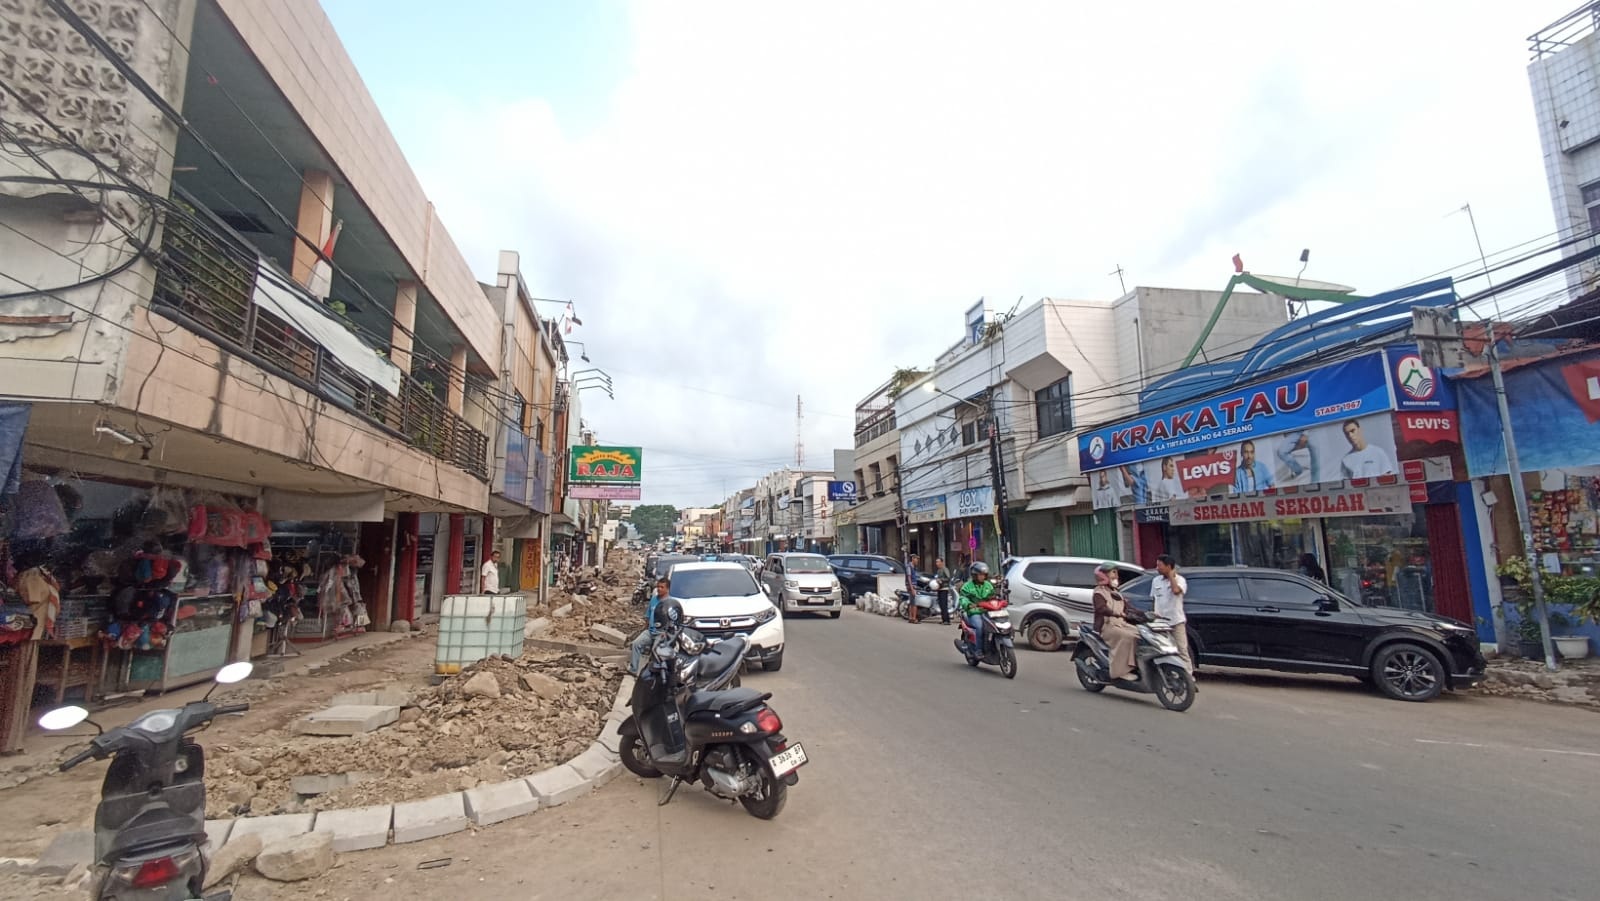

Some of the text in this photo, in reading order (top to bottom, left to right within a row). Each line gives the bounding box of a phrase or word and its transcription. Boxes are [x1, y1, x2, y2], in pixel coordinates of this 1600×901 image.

[1111, 380, 1309, 452] KRAKATAU
[1315, 399, 1361, 417] START 1967
[1167, 435, 1200, 449] TIRTAYASA
[1201, 433, 1211, 441] NO
[1213, 431, 1221, 439] 64
[1223, 424, 1253, 436] SERANG
[576, 462, 635, 477] RAJA
[960, 490, 977, 507] JOY
[1194, 501, 1266, 521] SERAGAM
[1276, 493, 1365, 516] SEKOLAH
